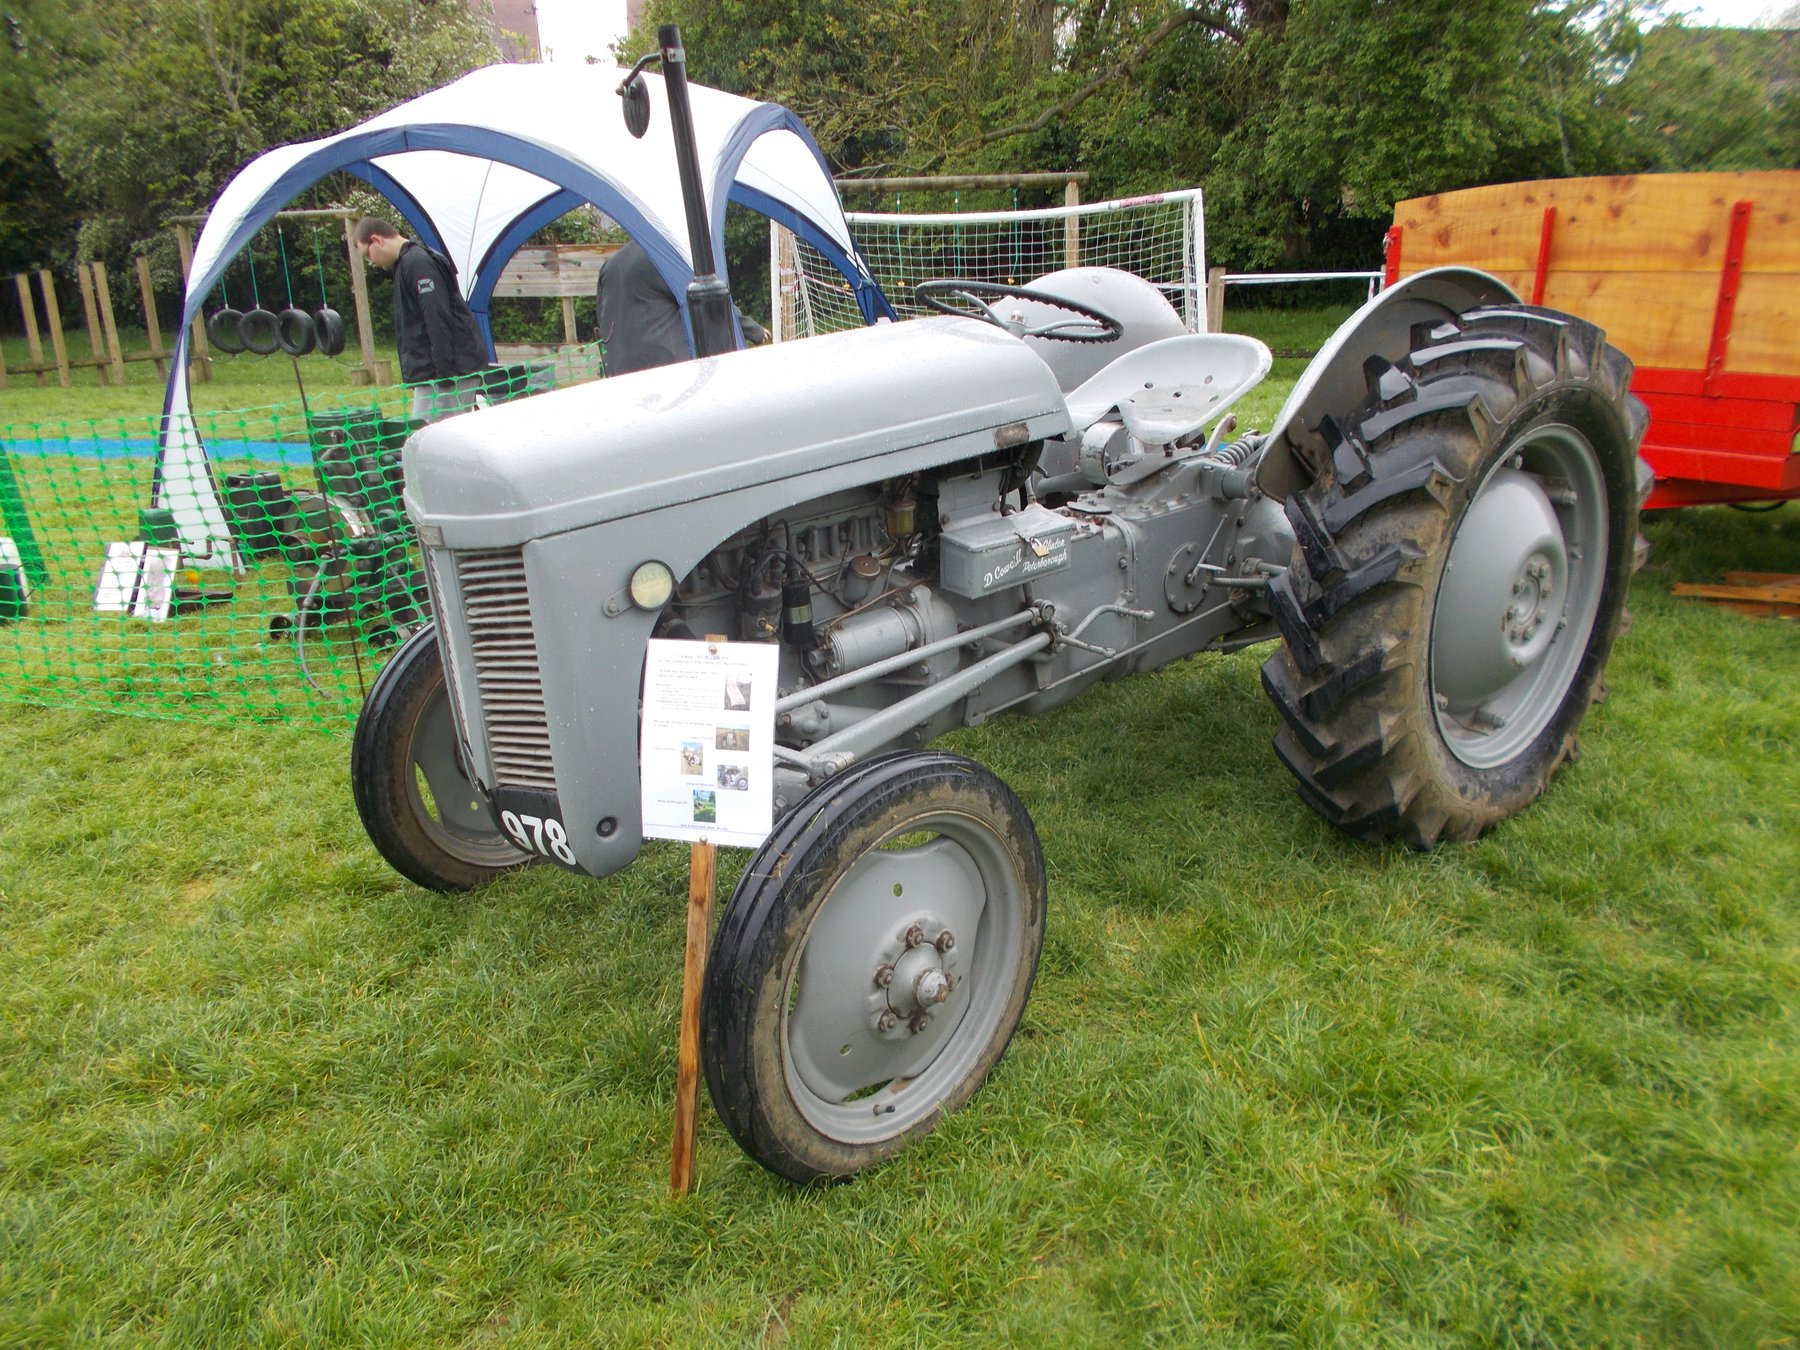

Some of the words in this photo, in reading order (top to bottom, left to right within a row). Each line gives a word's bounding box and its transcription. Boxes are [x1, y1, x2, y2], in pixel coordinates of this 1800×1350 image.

[1022, 549, 1067, 573] Peterborough
[983, 572, 993, 588] D
[501, 810, 577, 865] 978
